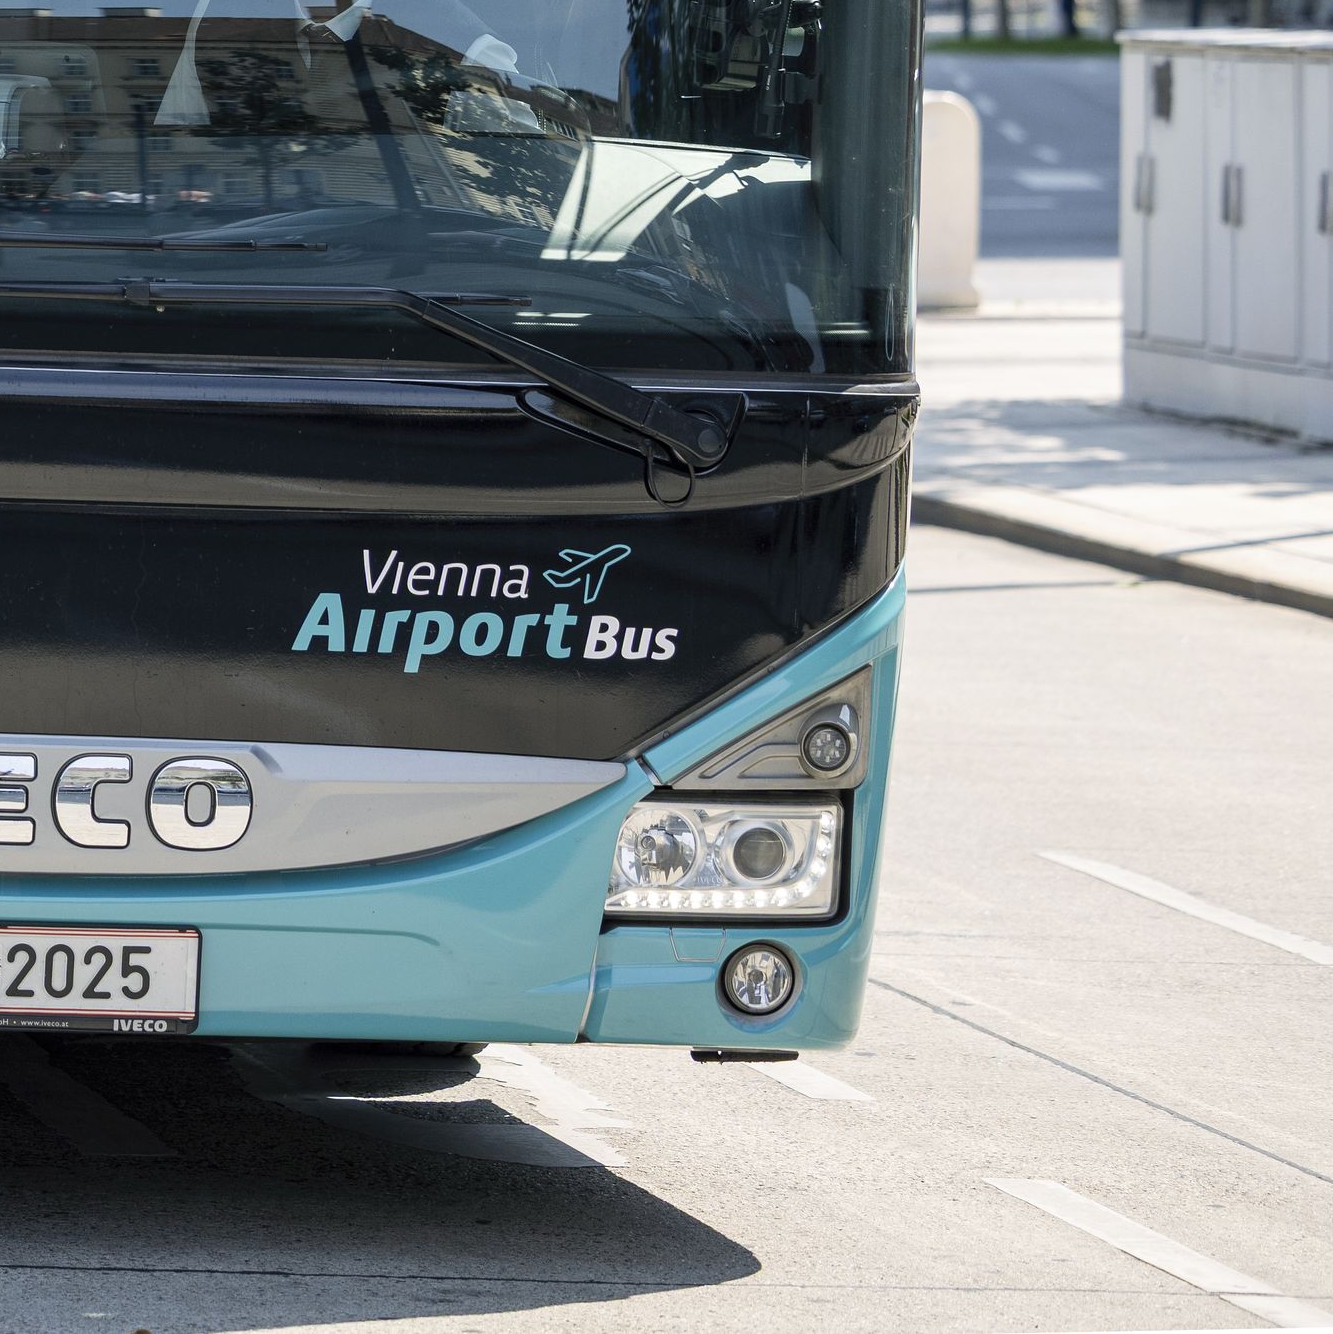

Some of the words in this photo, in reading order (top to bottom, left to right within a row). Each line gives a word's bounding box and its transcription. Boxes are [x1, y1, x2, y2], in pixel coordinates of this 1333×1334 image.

[362, 549, 530, 599] Vienna
[290, 592, 578, 673] Airport
[583, 614, 680, 662] Bus
[5, 942, 152, 1000] 2025
[20, 1019, 69, 1027] www.iveco.at
[112, 1018, 168, 1032] IVECO
